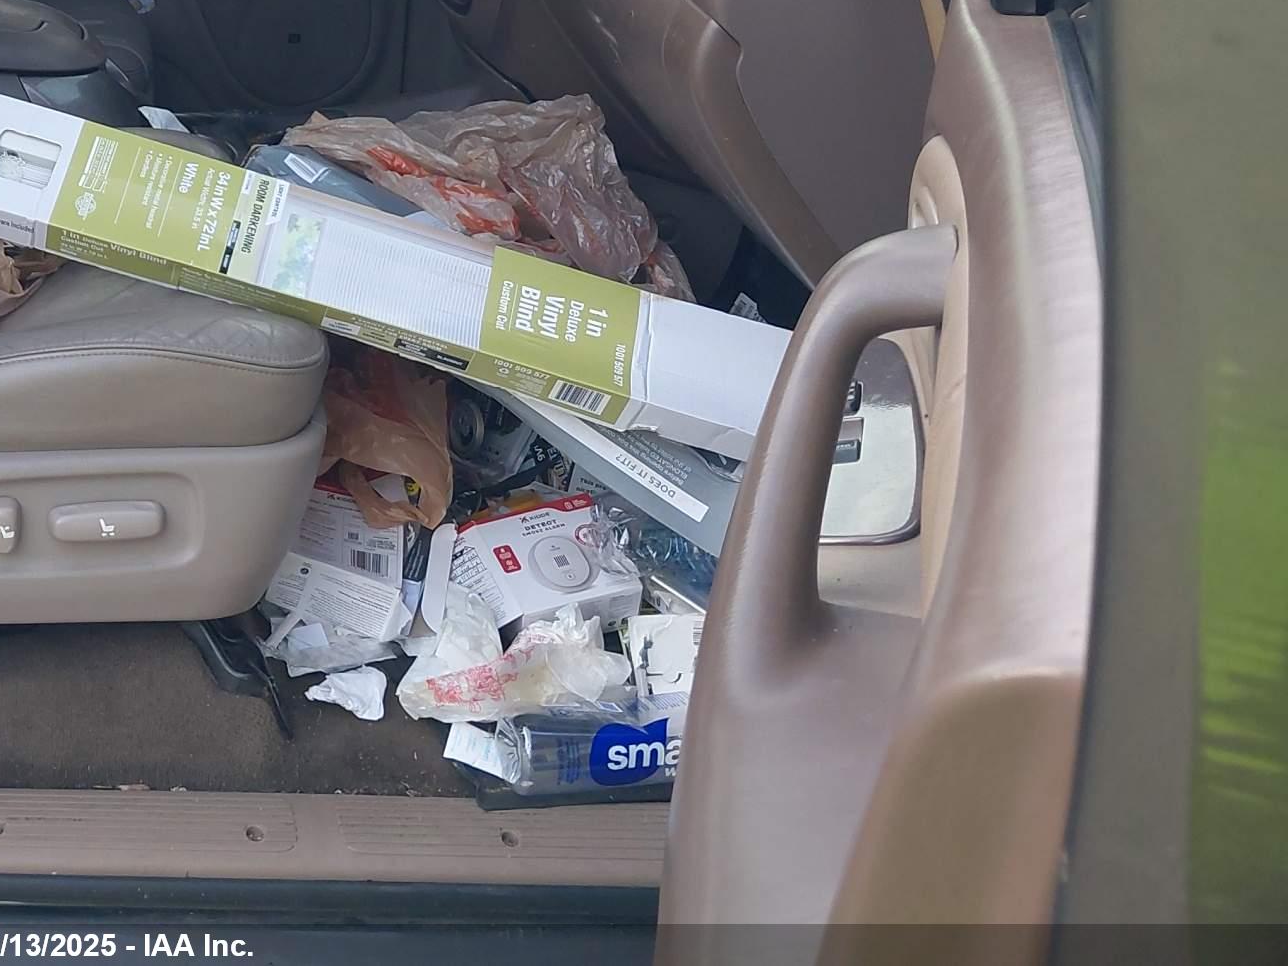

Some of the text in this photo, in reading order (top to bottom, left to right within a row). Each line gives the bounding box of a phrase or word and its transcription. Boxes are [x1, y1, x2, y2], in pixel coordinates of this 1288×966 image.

[179, 162, 199, 193] White
[241, 179, 270, 254] ROOM DARKENING
[110, 243, 136, 256] Vinyl
[139, 251, 167, 265] Blind
[495, 280, 514, 330] Custom Cut
[515, 285, 541, 332] Blind
[538, 296, 565, 339] Vinyl
[564, 300, 585, 342] Deluxe
[586, 308, 608, 337] 1 in
[494, 359, 551, 380] 1001 509 577
[615, 453, 676, 498] DOES IT FIT?
[524, 519, 557, 532] DETECT
[607, 738, 683, 771] sma
